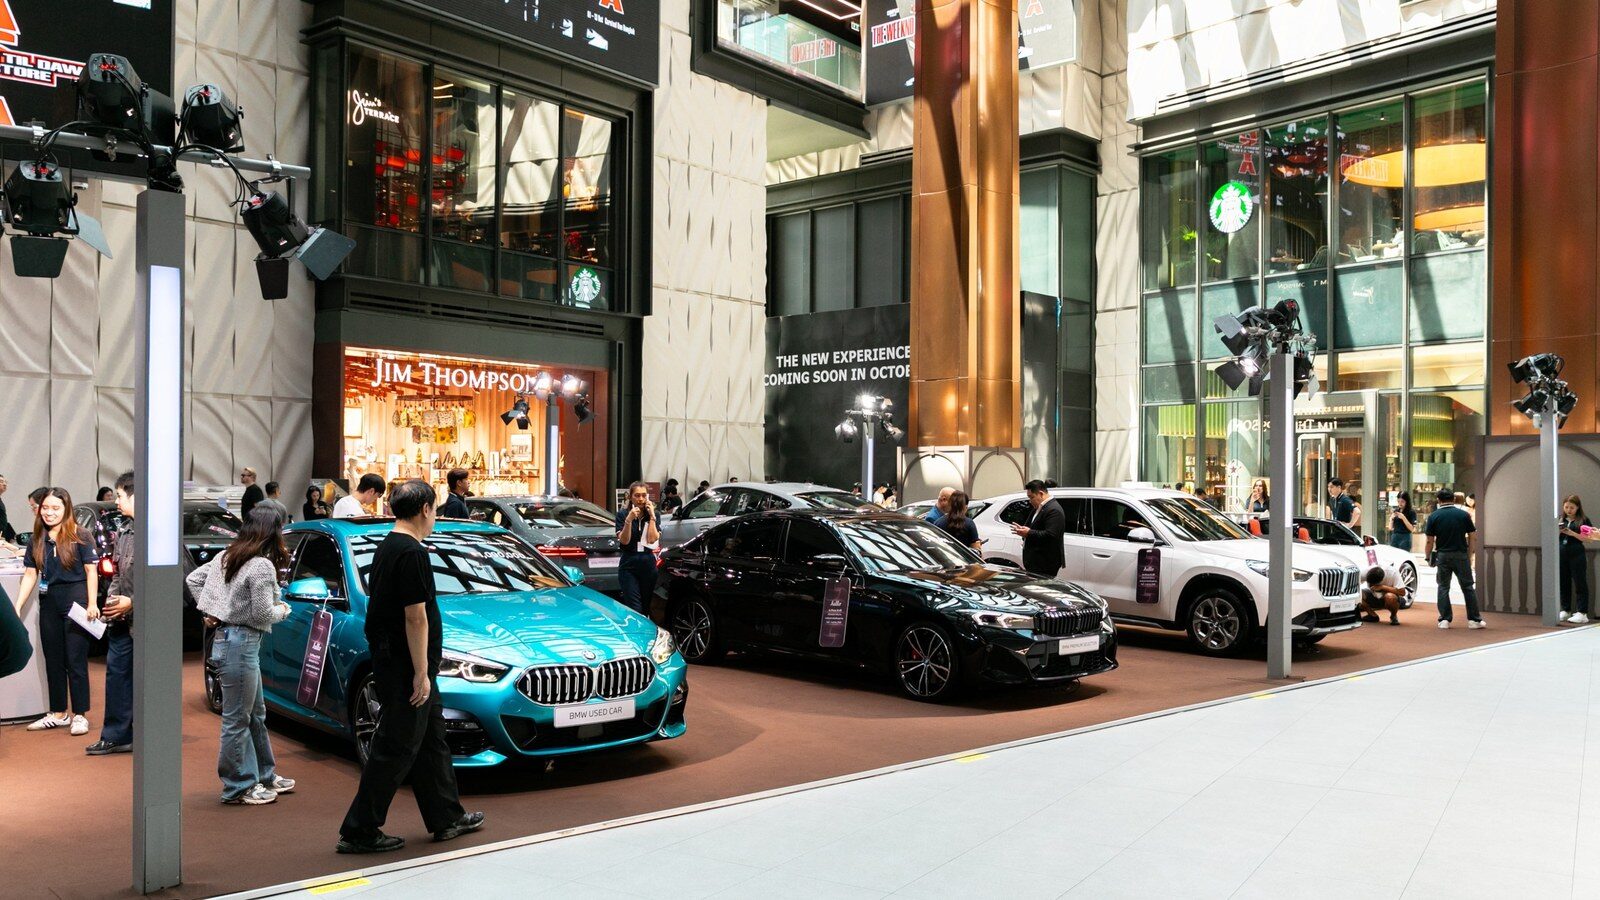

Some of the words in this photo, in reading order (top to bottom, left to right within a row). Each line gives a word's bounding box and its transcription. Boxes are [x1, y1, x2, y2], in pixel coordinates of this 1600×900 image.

[0, 63, 52, 82] TORE
[37, 59, 84, 76] DAW
[363, 107, 400, 124] TERRACE
[776, 354, 799, 368] THE
[801, 352, 829, 366] NEW
[832, 345, 911, 364] EXPERIENCE
[371, 358, 412, 388] JIM
[763, 371, 810, 386] COMING
[812, 369, 848, 384] SOON
[850, 367, 866, 381] IN
[569, 711, 588, 720] BMW
[588, 708, 608, 718] USED
[608, 706, 623, 715] CAR
